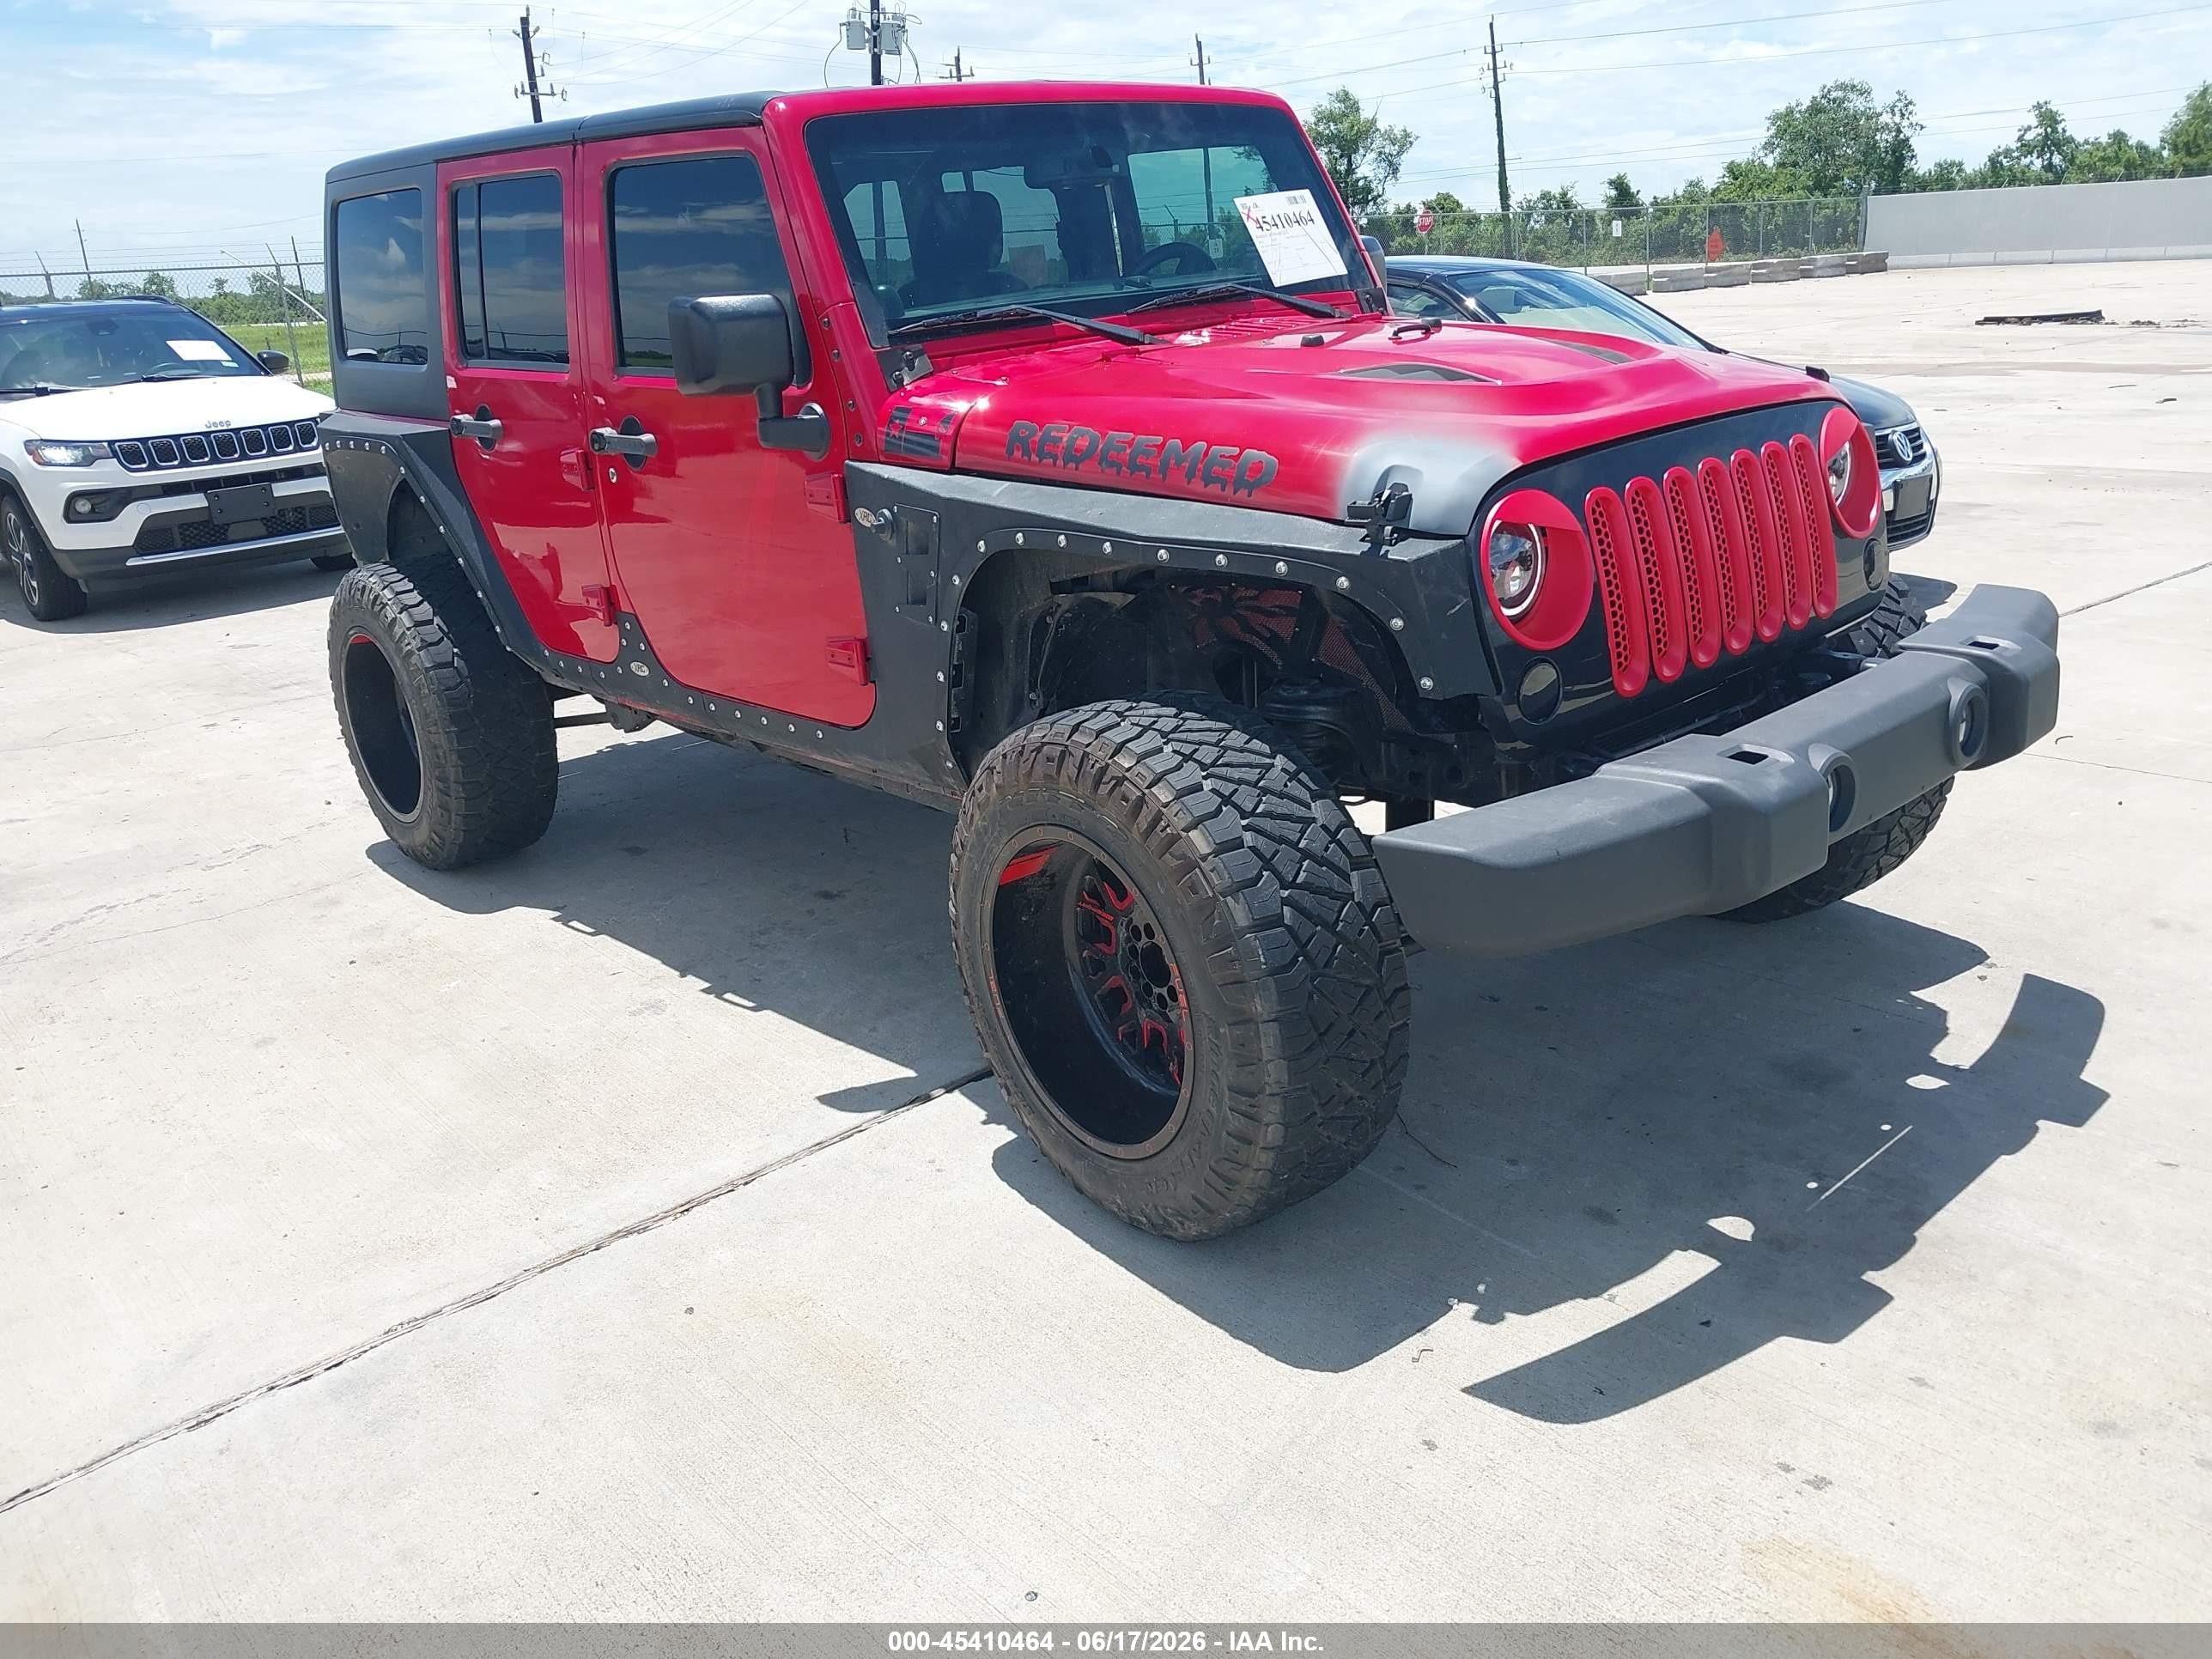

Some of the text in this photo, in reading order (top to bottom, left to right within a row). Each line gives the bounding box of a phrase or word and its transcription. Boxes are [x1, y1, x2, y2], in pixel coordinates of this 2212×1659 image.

[1255, 210, 1316, 232] 45410464
[1419, 216, 1432, 227] STOP
[204, 420, 231, 428] Jeep
[1005, 421, 1279, 498] REDEEMED
[1170, 963, 1189, 1022] FUEL
